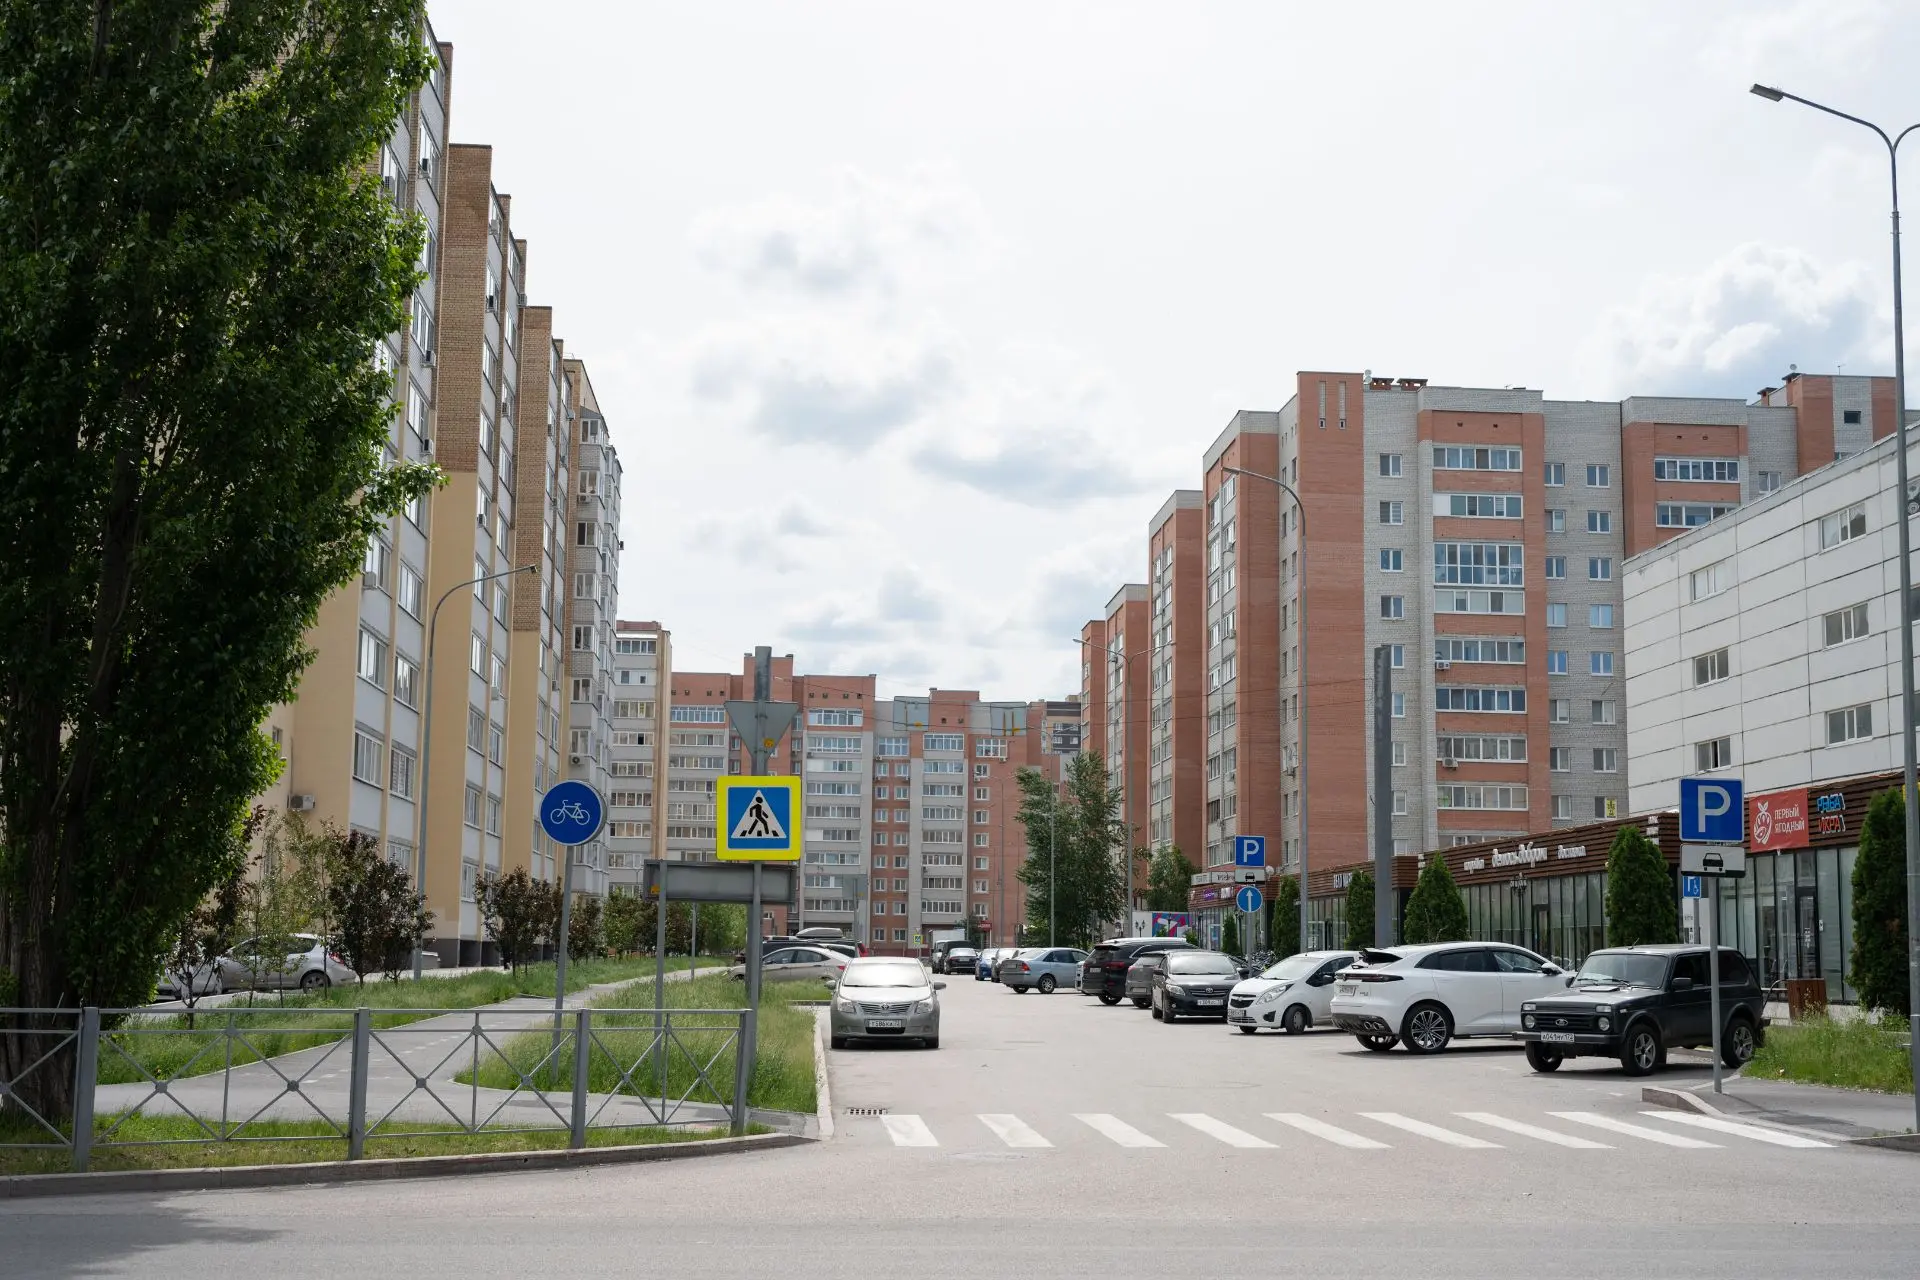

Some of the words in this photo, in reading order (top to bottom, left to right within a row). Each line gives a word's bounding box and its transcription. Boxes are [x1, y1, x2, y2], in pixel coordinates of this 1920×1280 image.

[1698, 785, 1731, 833] P
[1774, 803, 1800, 820] ПЕРВЫЙ
[1816, 793, 1841, 813] РЫБА
[1774, 817, 1805, 834] ЯГОДНЫЙ
[1818, 815, 1842, 833] ИКРА
[1243, 839, 1259, 863] P
